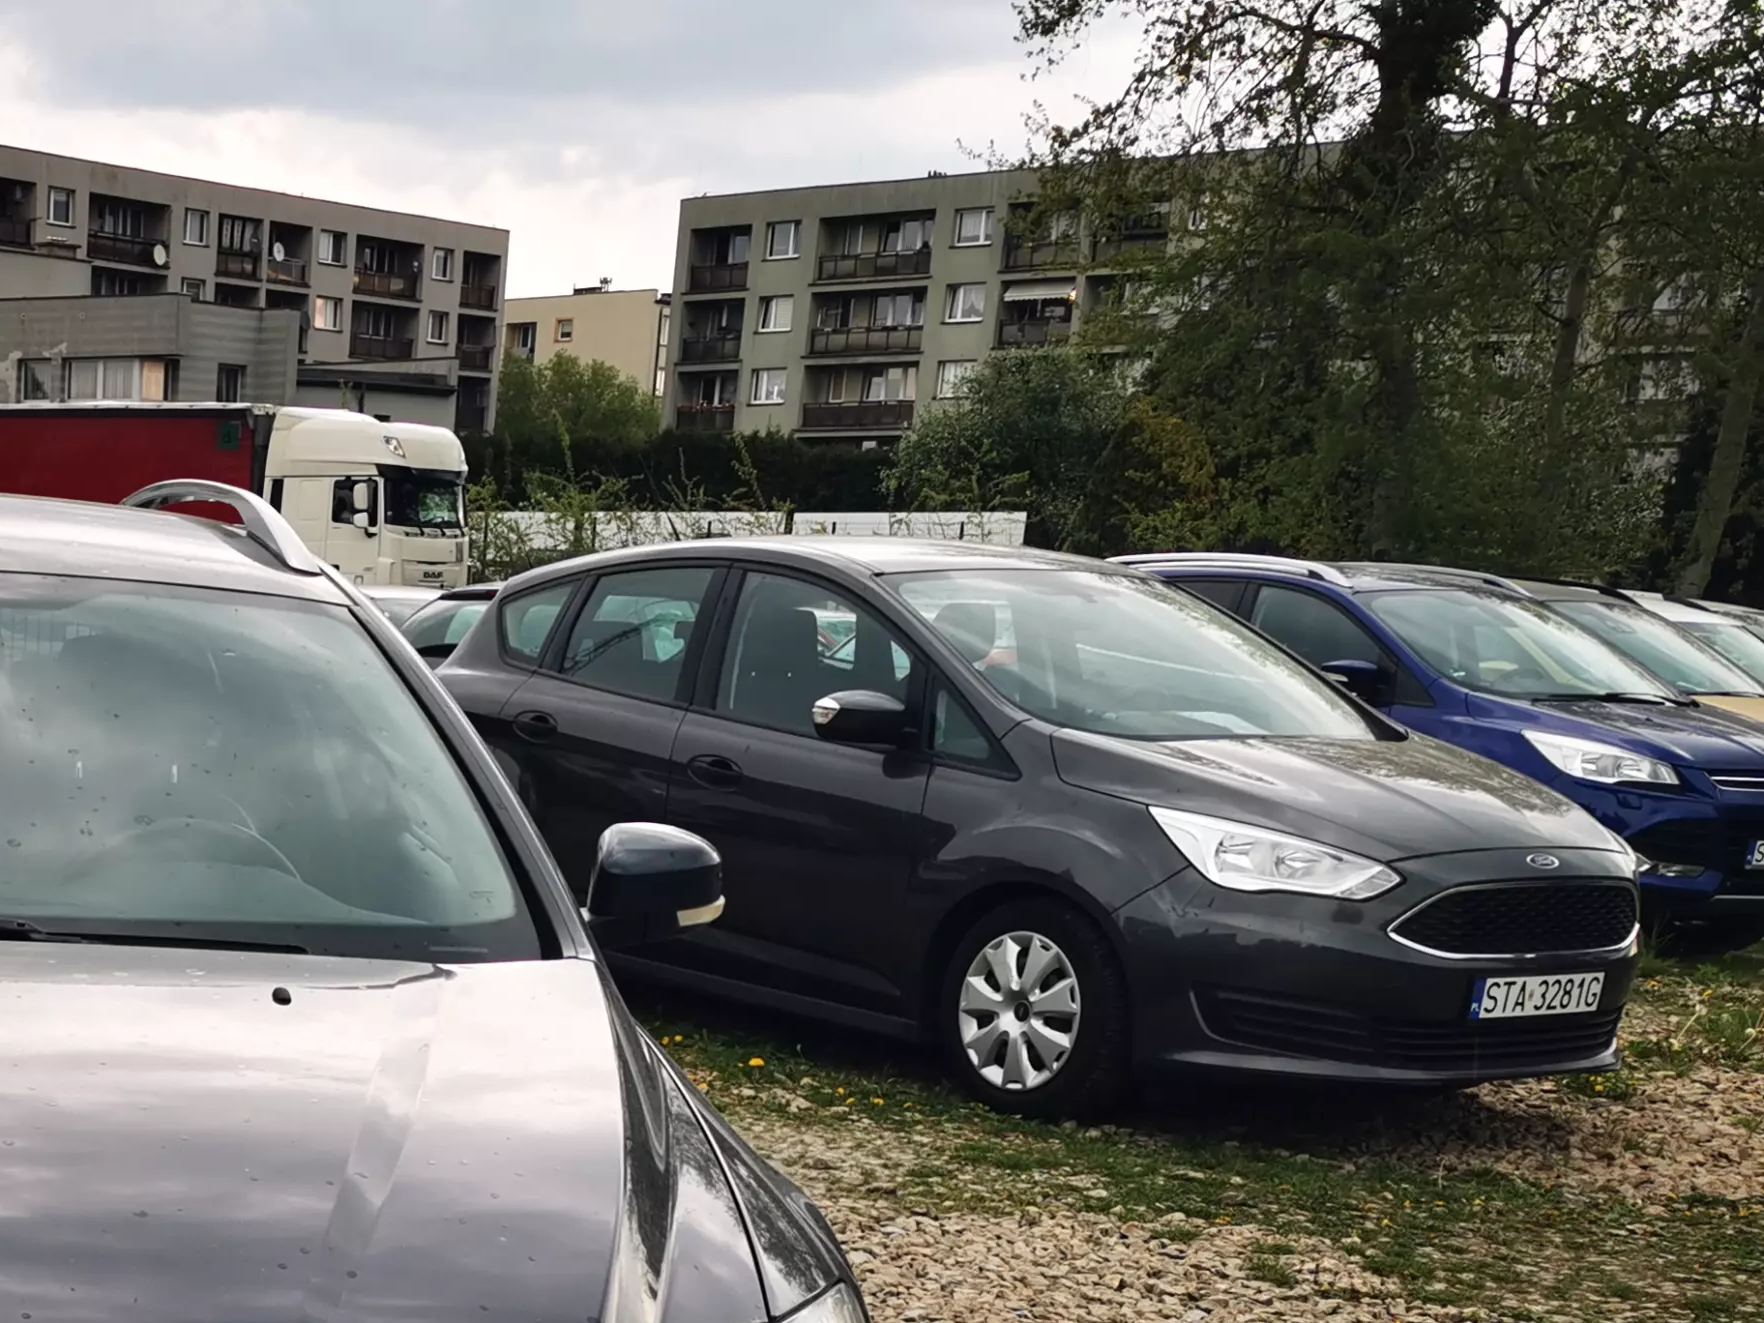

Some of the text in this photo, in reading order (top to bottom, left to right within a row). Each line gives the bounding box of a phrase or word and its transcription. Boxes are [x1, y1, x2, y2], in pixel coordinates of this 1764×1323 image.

[423, 571, 444, 579] DAF
[1483, 980, 1527, 1014] STA
[1533, 976, 1601, 1011] 3281G
